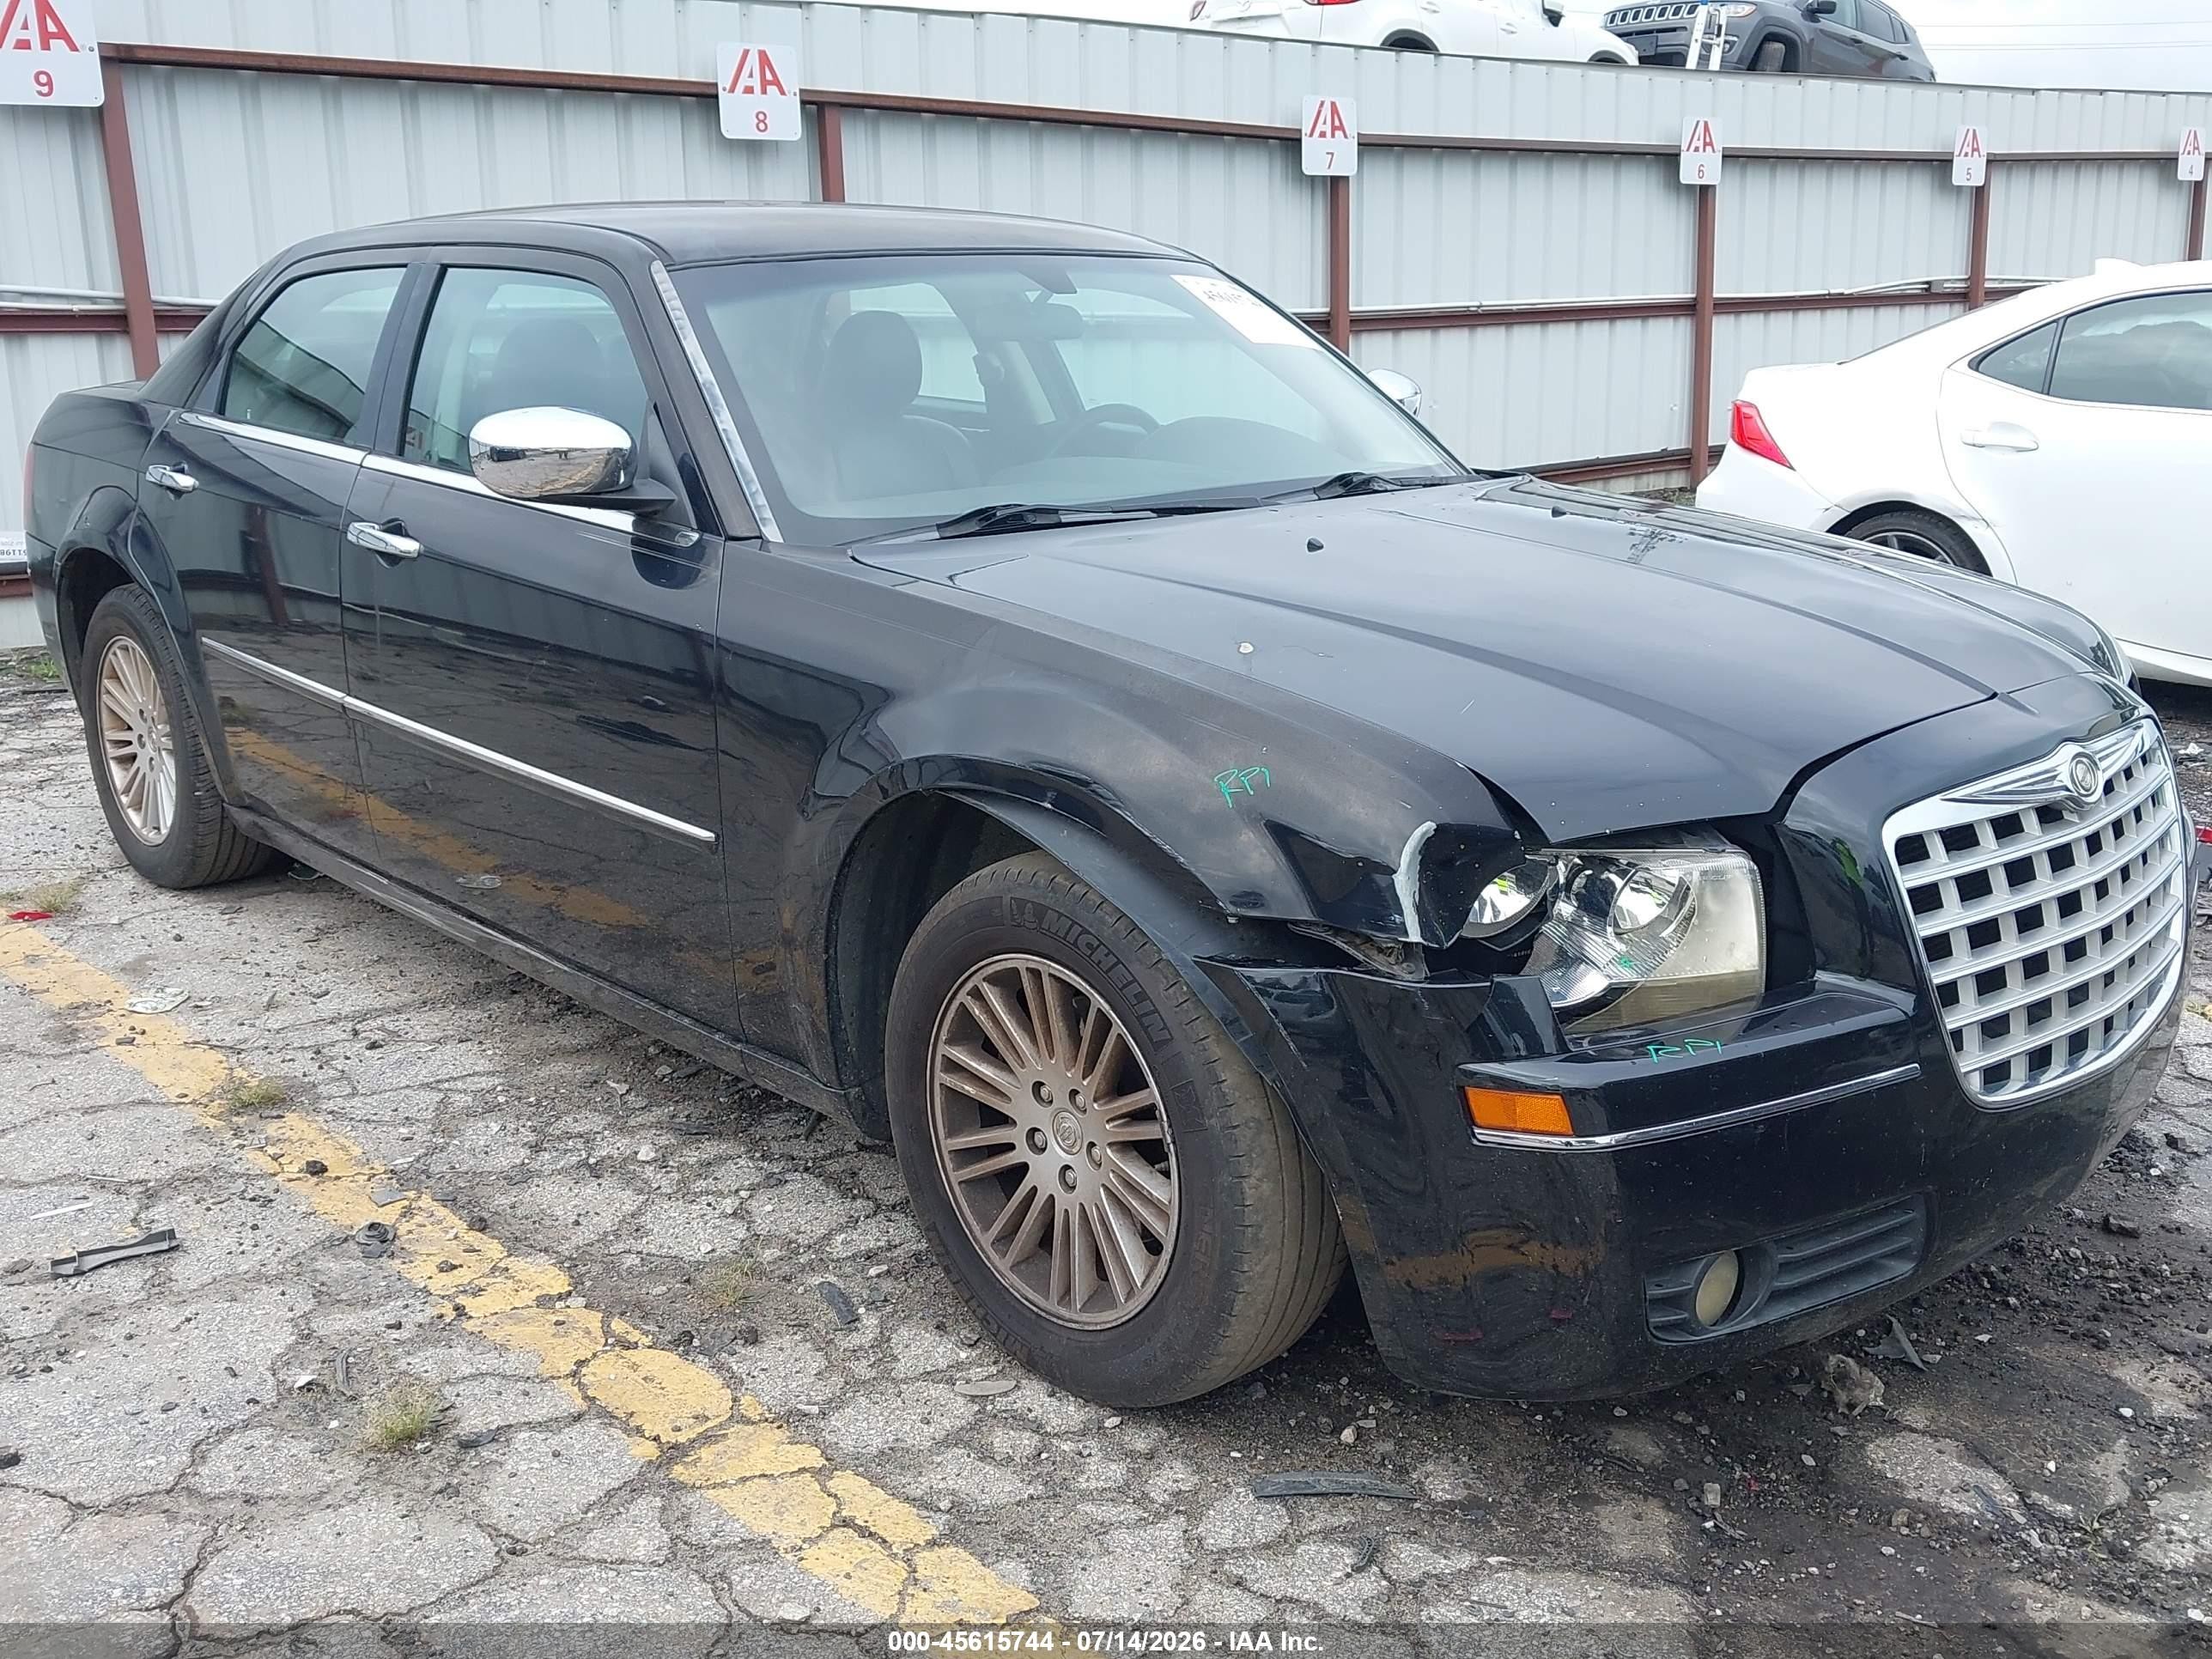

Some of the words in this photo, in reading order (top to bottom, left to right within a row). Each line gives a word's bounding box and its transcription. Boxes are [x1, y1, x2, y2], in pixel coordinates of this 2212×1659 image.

[33, 70, 54, 97] 9
[756, 111, 768, 132] 8
[1326, 152, 1334, 169] 7
[1698, 163, 1705, 179] 6
[1966, 167, 1972, 181] 5
[2189, 164, 2194, 175] 4
[1041, 908, 1173, 1042] MICHELIN
